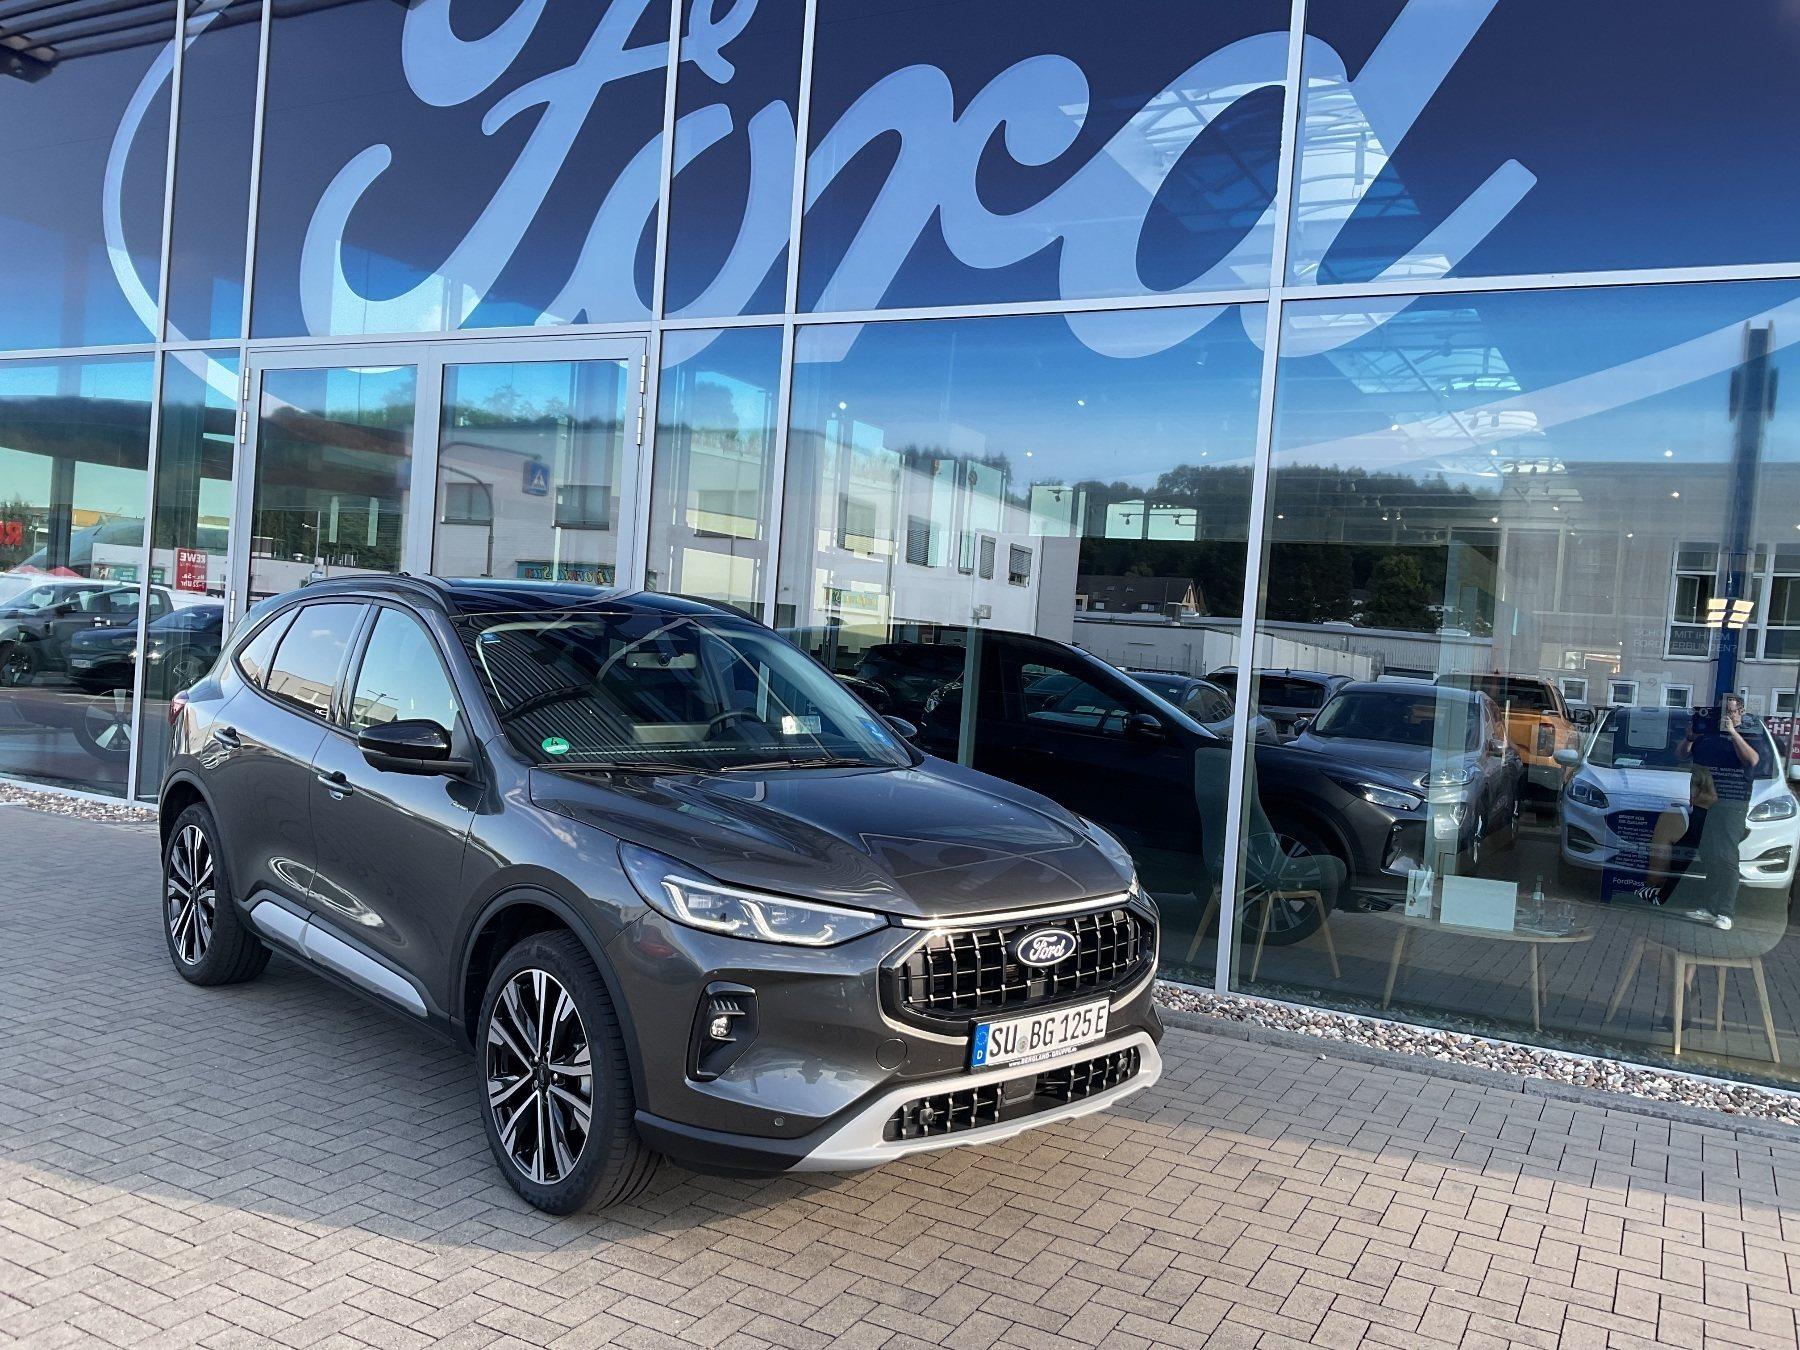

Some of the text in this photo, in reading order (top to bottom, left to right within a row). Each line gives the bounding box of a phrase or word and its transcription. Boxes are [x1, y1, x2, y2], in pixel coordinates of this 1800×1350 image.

[300, 0, 1537, 370] Ford
[1674, 630, 1694, 639] MIT
[1029, 935, 1066, 961] Ford
[988, 1023, 1018, 1058] SU
[1029, 1017, 1055, 1049] BG
[976, 1049, 983, 1060] D
